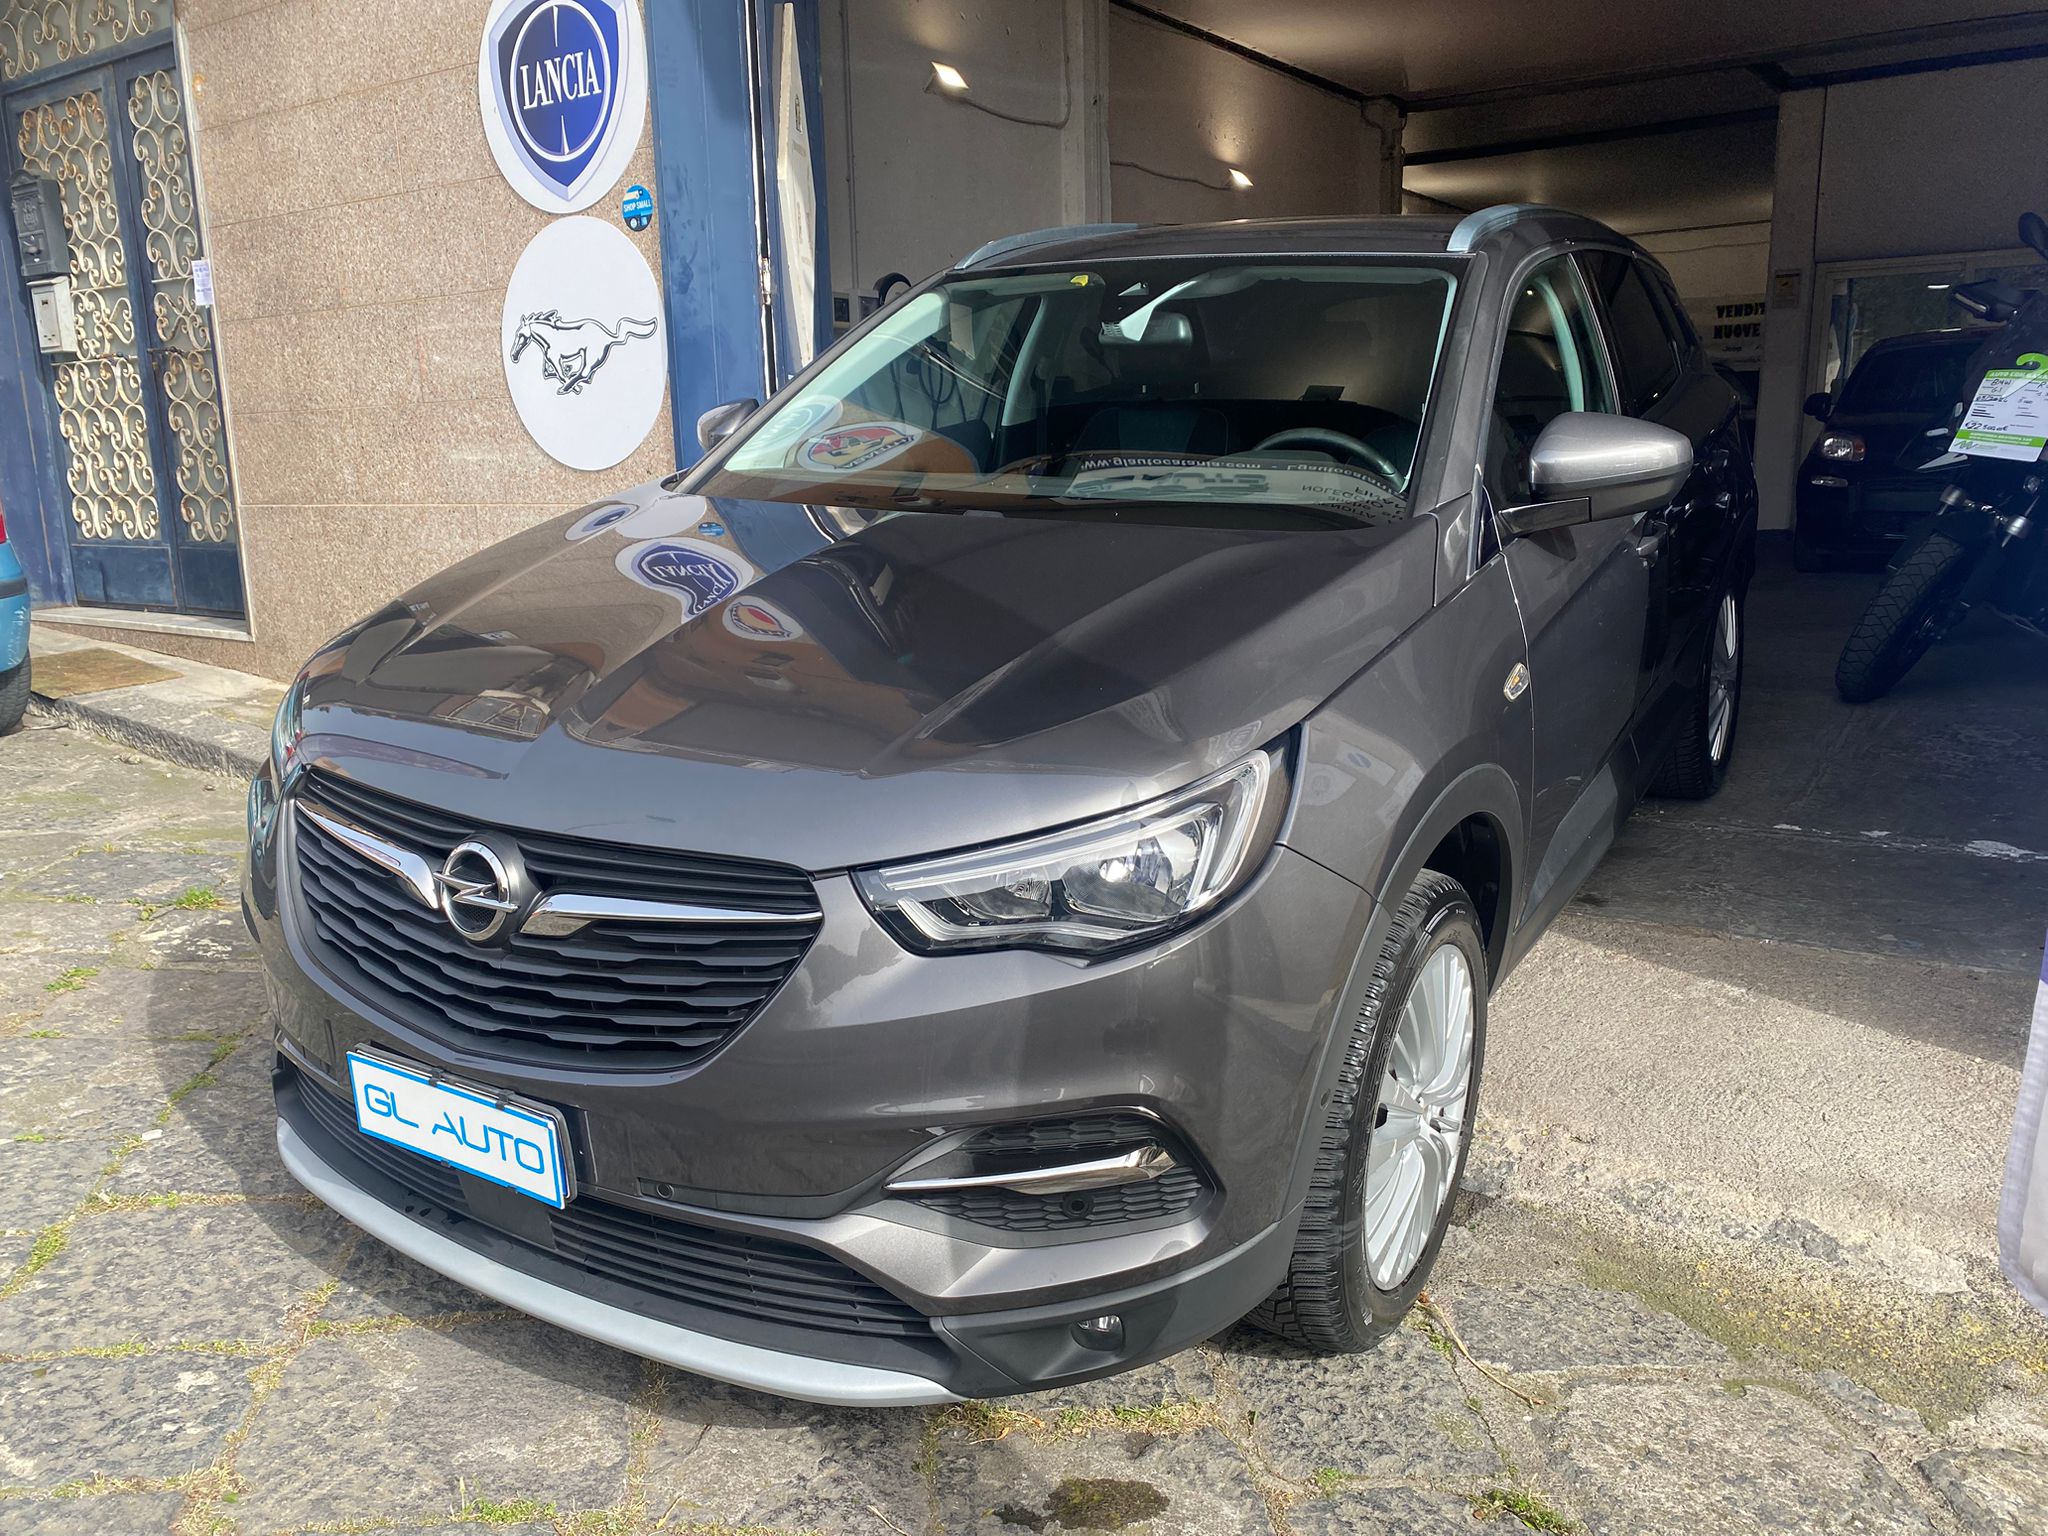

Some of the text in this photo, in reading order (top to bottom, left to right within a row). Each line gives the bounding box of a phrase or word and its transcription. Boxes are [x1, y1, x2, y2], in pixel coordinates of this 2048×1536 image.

[520, 49, 602, 109] LANCIA
[623, 199, 652, 213] SHOP SMALL
[1713, 323, 1760, 339] NUOVE
[364, 1083, 545, 1174] GL AUTO
